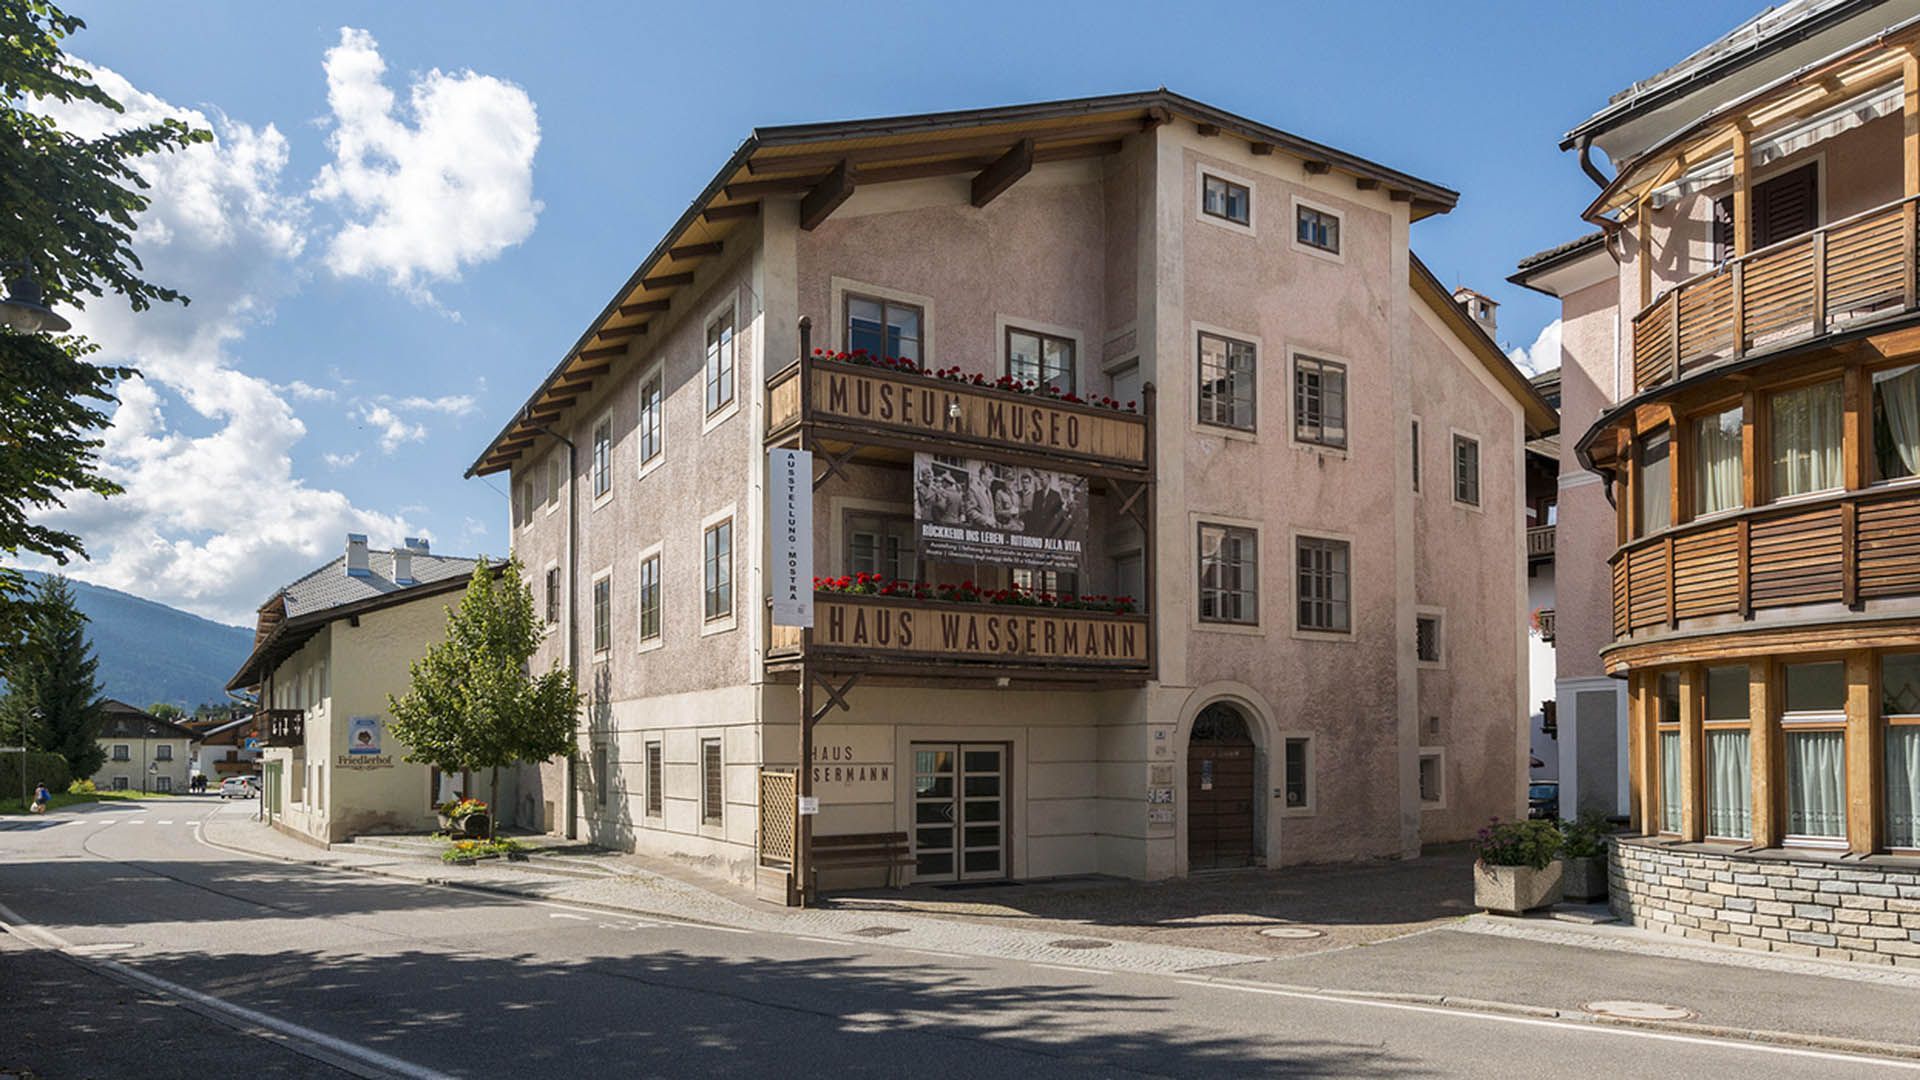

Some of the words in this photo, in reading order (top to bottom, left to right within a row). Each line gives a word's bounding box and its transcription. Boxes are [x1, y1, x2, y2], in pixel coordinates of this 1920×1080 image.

[829, 375, 963, 432] MUSEUM
[987, 401, 1078, 448] MUSEO
[787, 452, 796, 543] AUSSTELLUNG
[922, 523, 964, 540] RÜCKKEHR
[966, 529, 979, 542] INS
[981, 531, 1004, 545] LEBEN
[1010, 534, 1042, 549] RITORNO
[1044, 537, 1063, 551] ALLA
[1064, 539, 1081, 553] VITA
[788, 551, 797, 600] MOSTRA
[829, 606, 913, 646] HAUS
[941, 613, 1135, 657] WASSERMANN
[338, 755, 393, 765] Friedlerhof
